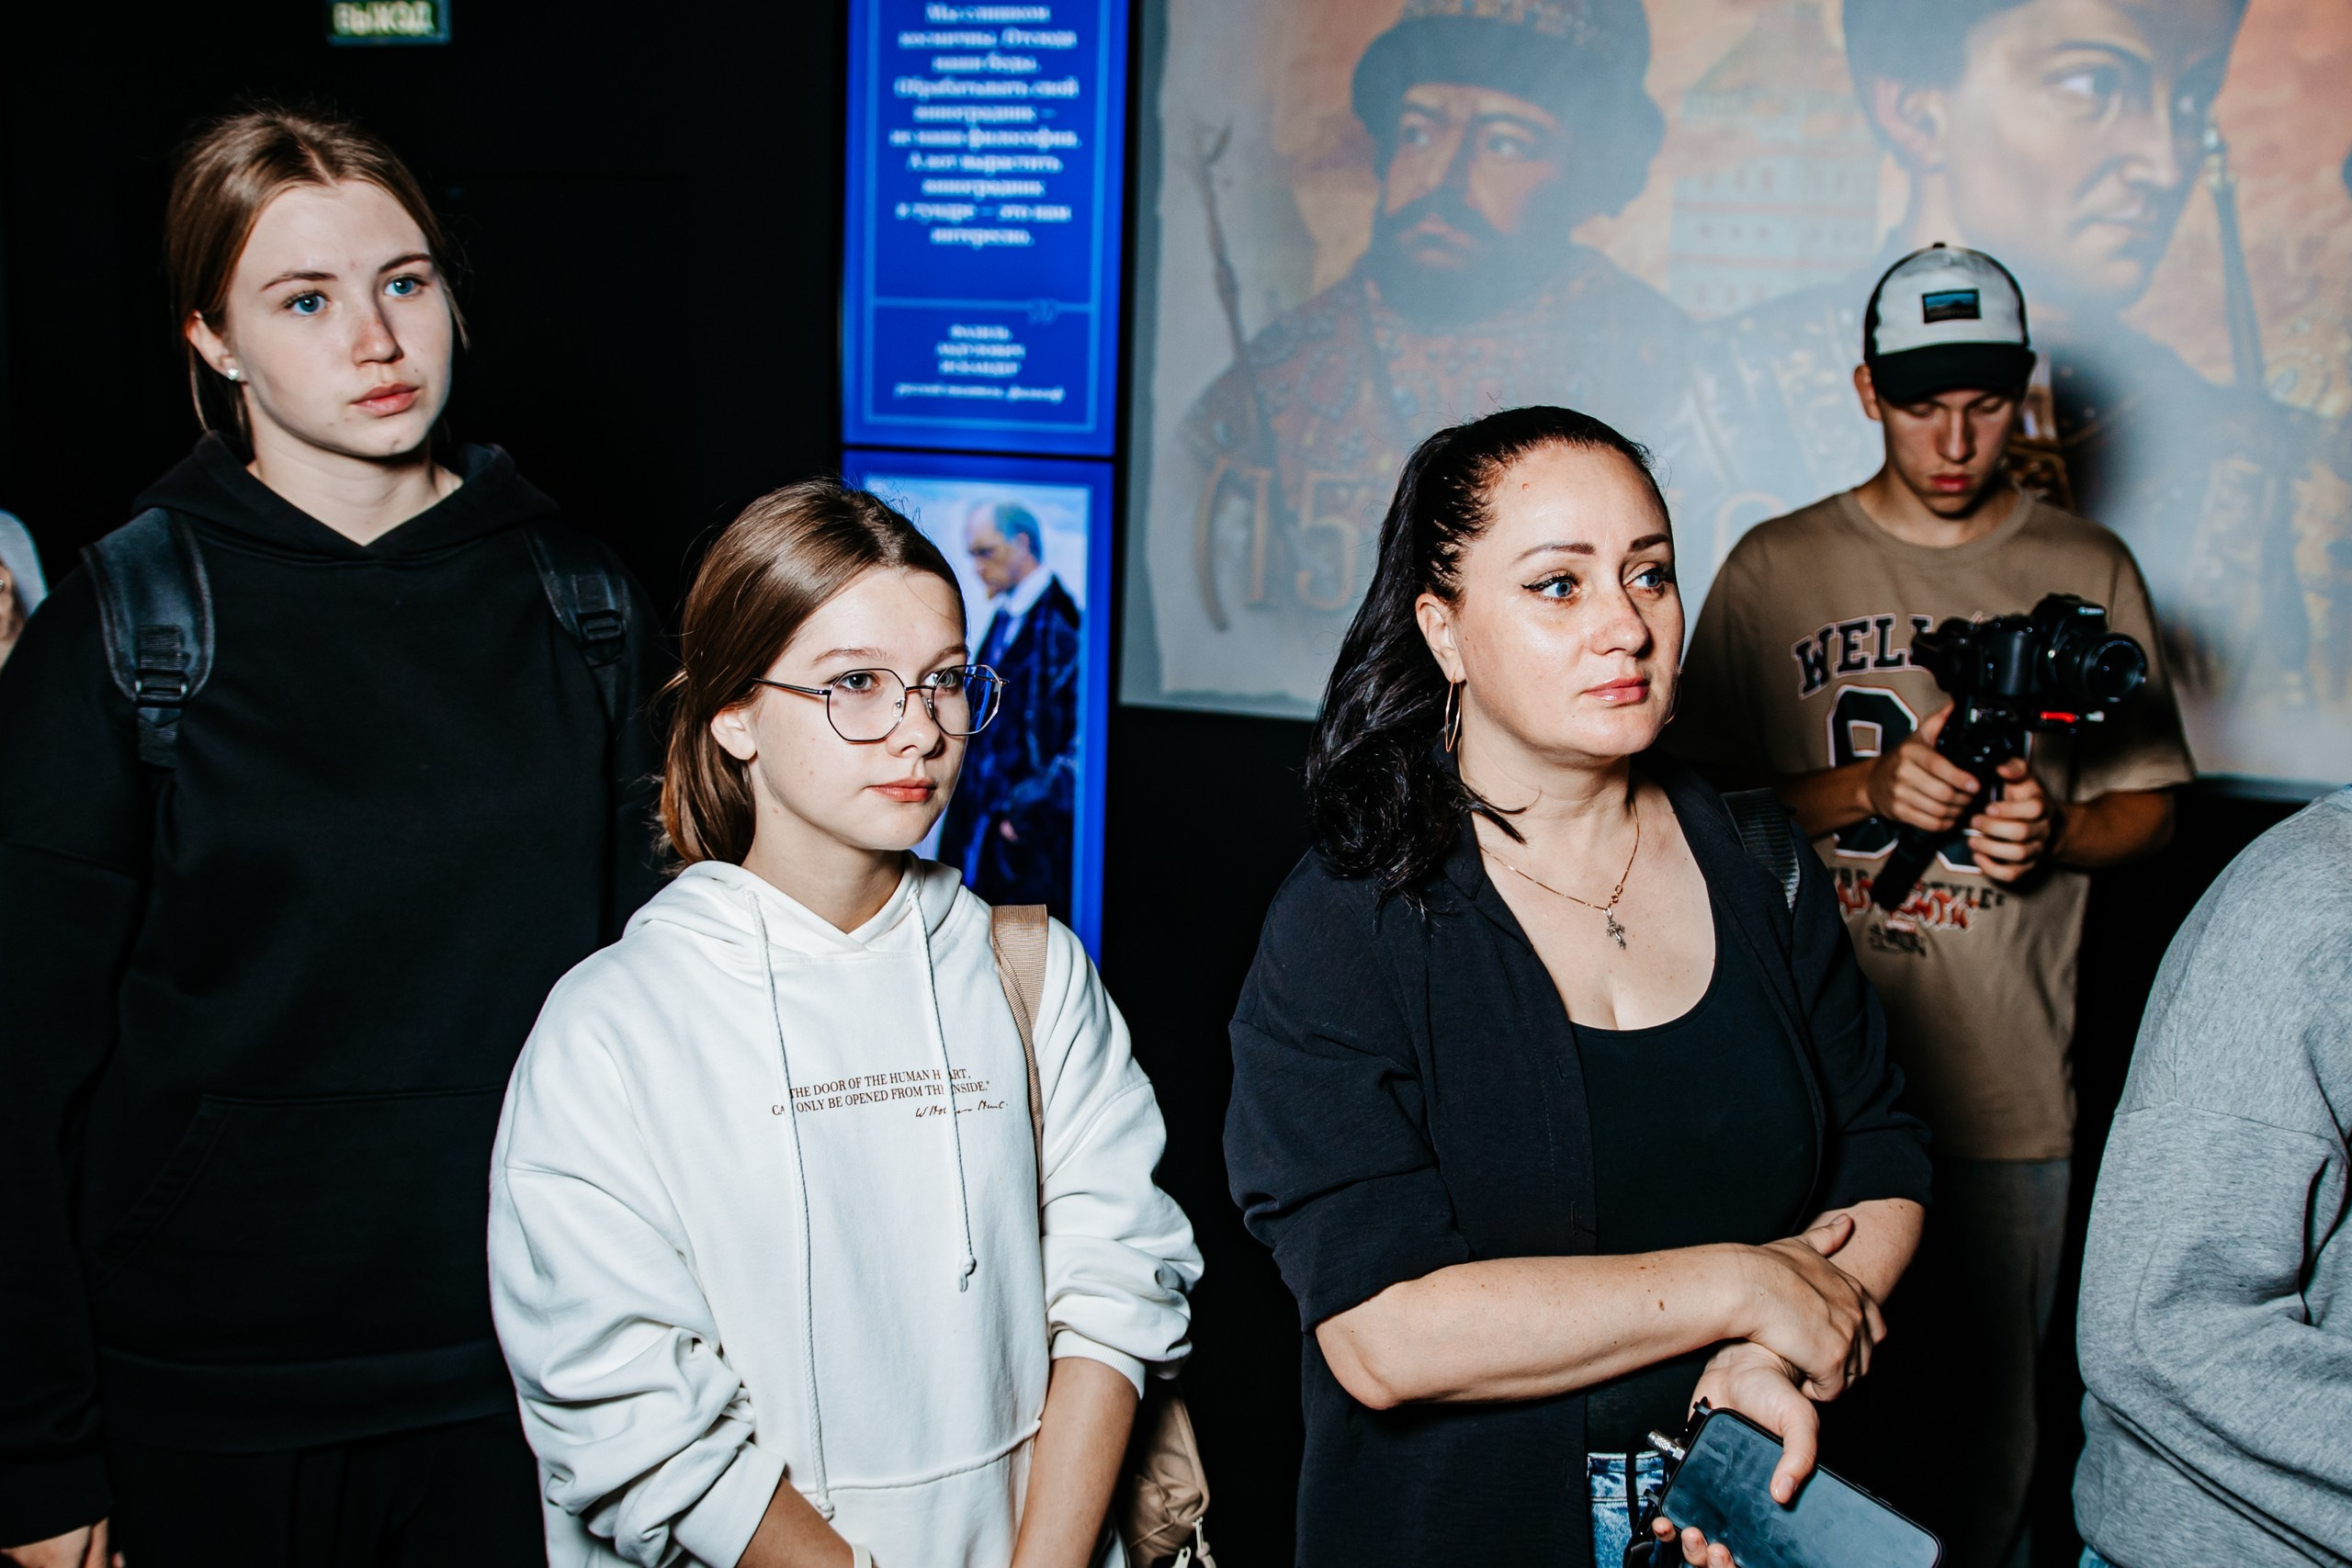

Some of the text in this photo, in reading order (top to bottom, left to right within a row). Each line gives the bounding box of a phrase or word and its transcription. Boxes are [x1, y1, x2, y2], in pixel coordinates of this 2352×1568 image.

[813, 1080, 846, 1096] DOOR
[848, 1077, 862, 1090] OF
[864, 1073, 888, 1088] THE
[888, 1069, 930, 1084] HUMAN
[771, 1104, 786, 1116] CA
[796, 1099, 825, 1113] ONLY
[828, 1096, 843, 1110] BE
[844, 1089, 889, 1106] OPENED
[890, 1085, 923, 1100] FROM
[924, 1083, 944, 1096] TH
